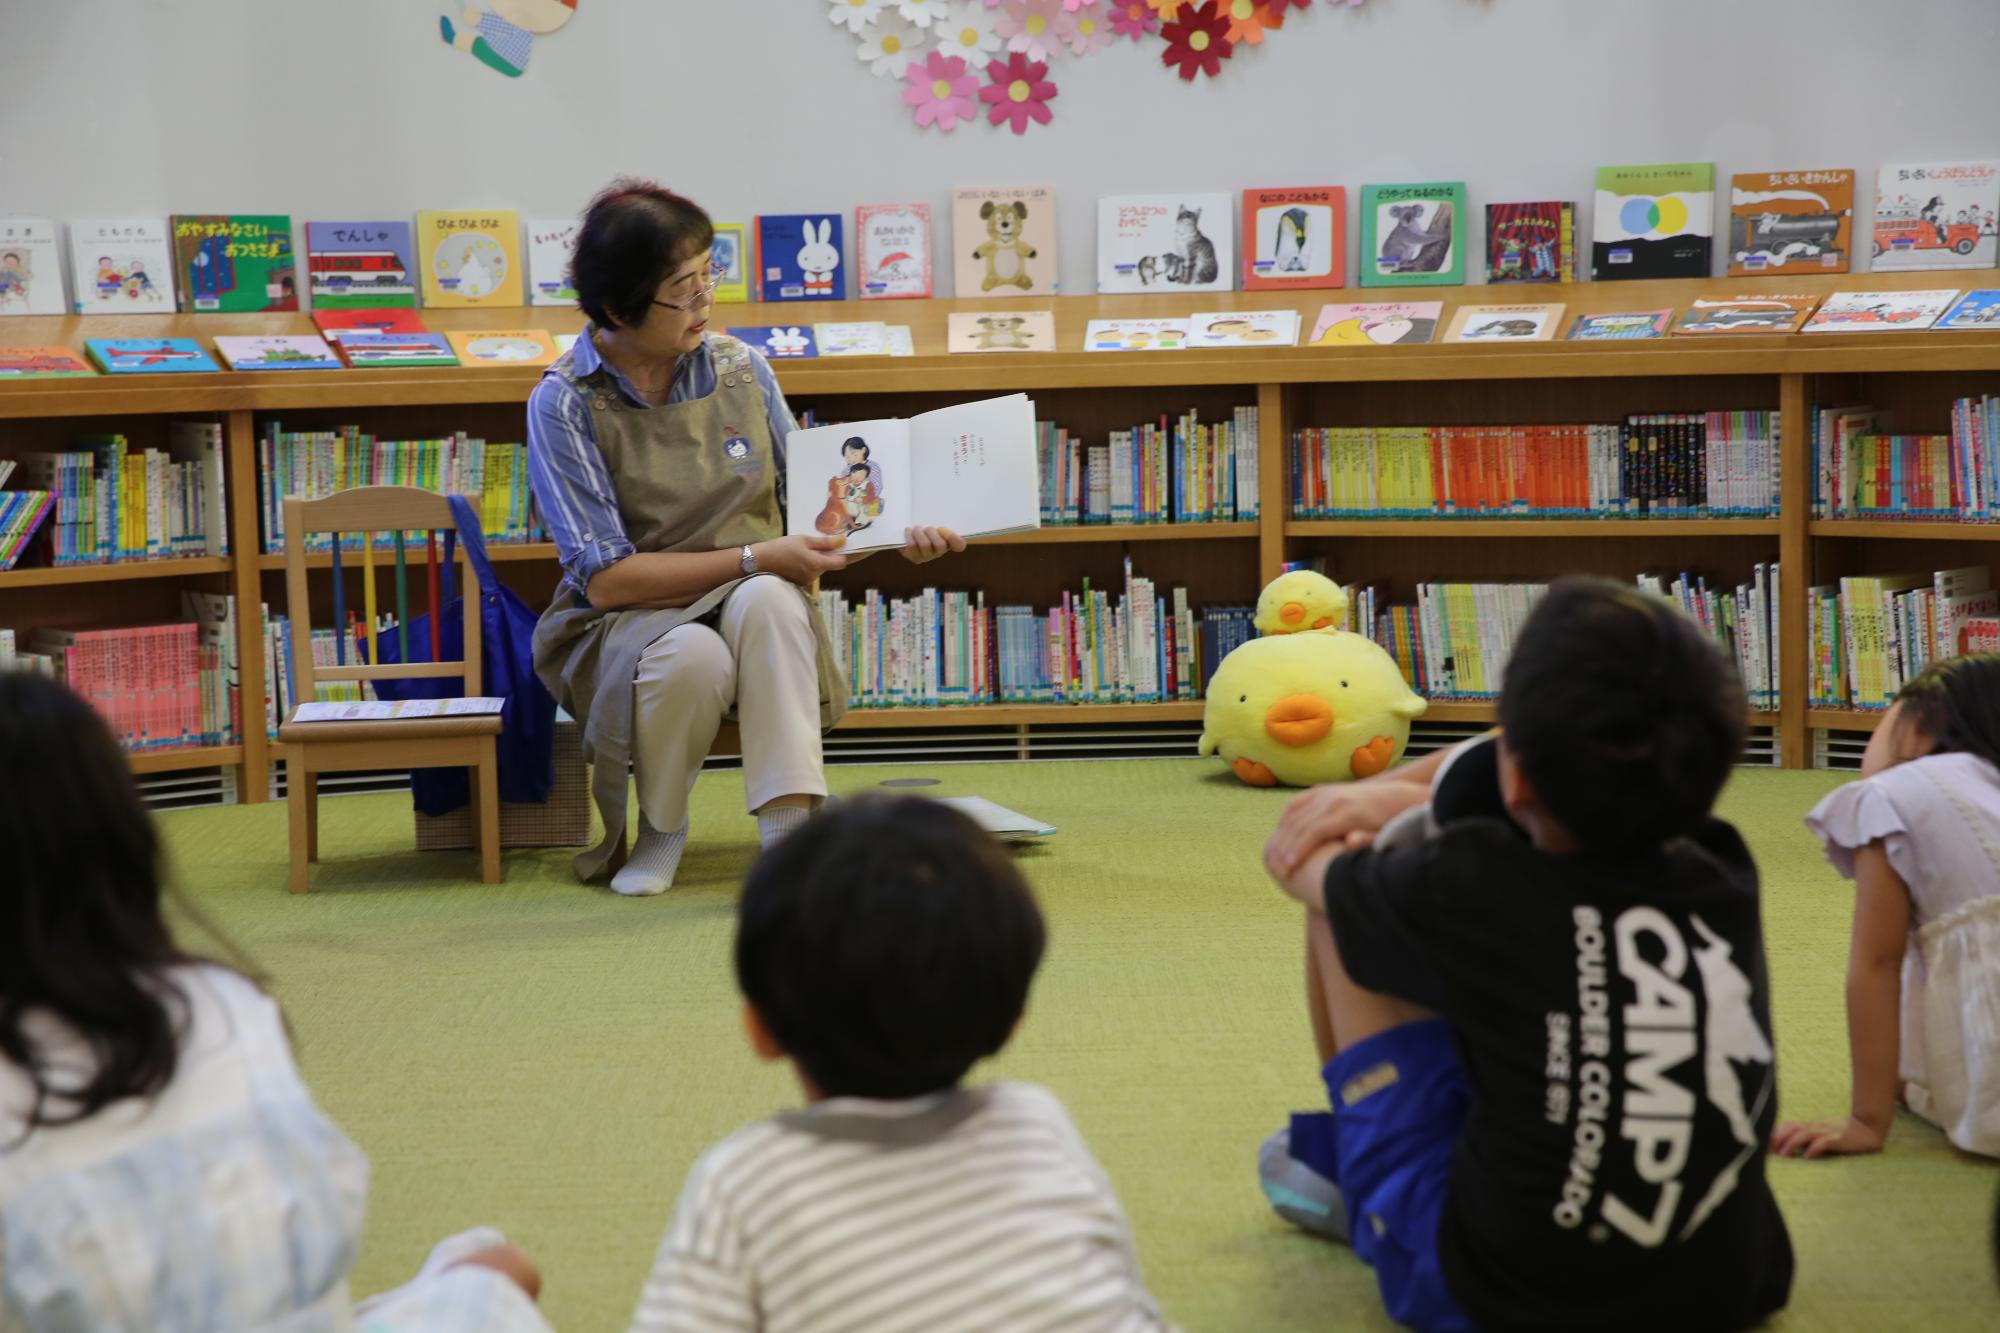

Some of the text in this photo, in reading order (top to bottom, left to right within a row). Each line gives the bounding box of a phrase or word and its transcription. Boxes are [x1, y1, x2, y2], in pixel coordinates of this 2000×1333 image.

[176, 223, 268, 238] おやすみなさい
[333, 229, 389, 242] でんしゃ
[1545, 1012, 1572, 1081] SINCE
[1552, 905, 1611, 1229] BOULDER COLORADO
